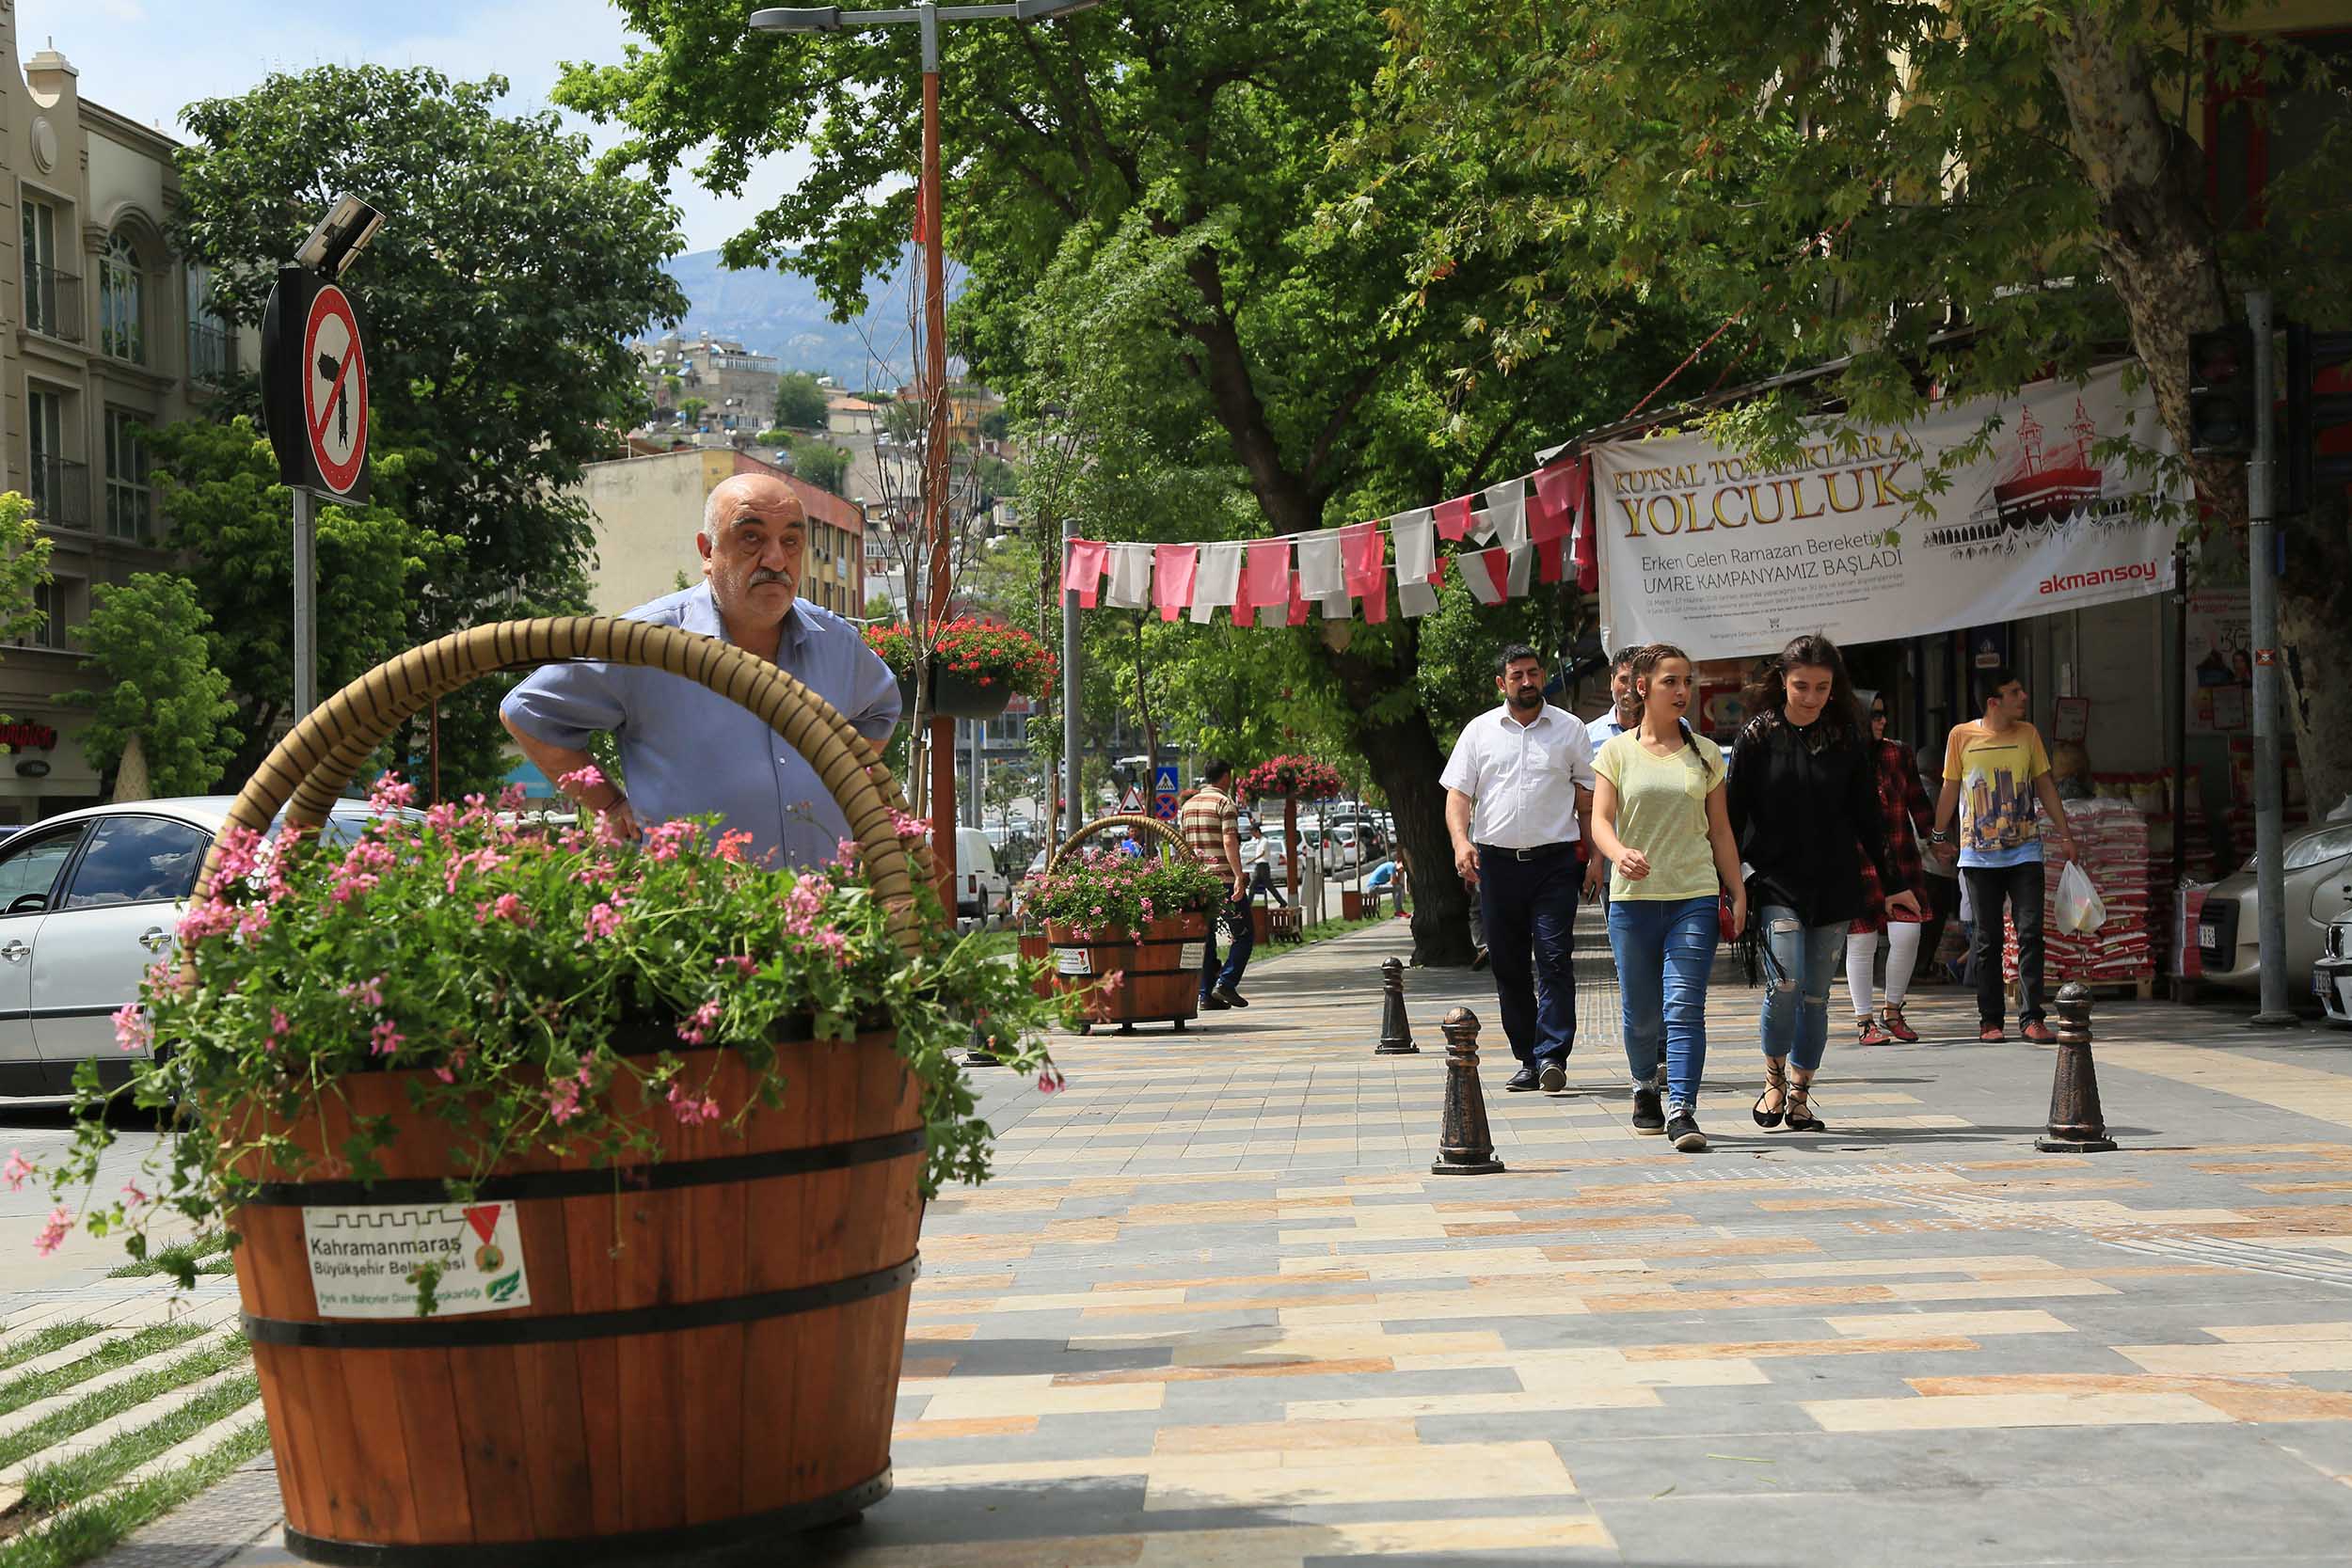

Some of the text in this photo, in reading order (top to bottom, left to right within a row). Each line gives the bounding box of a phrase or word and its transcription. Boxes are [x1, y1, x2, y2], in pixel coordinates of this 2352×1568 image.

[1612, 432, 1908, 495] KUTSAL TOPKLARA
[1616, 460, 1910, 537] YOLCULUK
[1641, 528, 1896, 573] Erken Gelen Ramazan Bereketiy
[1644, 548, 1903, 594] UMRE KAMPANYAMIZ BAŞLADI
[2039, 562, 2157, 594] akmansoy
[310, 1237, 462, 1257] Kahramanmaraş
[314, 1257, 467, 1278] Büyükşehir Belesi
